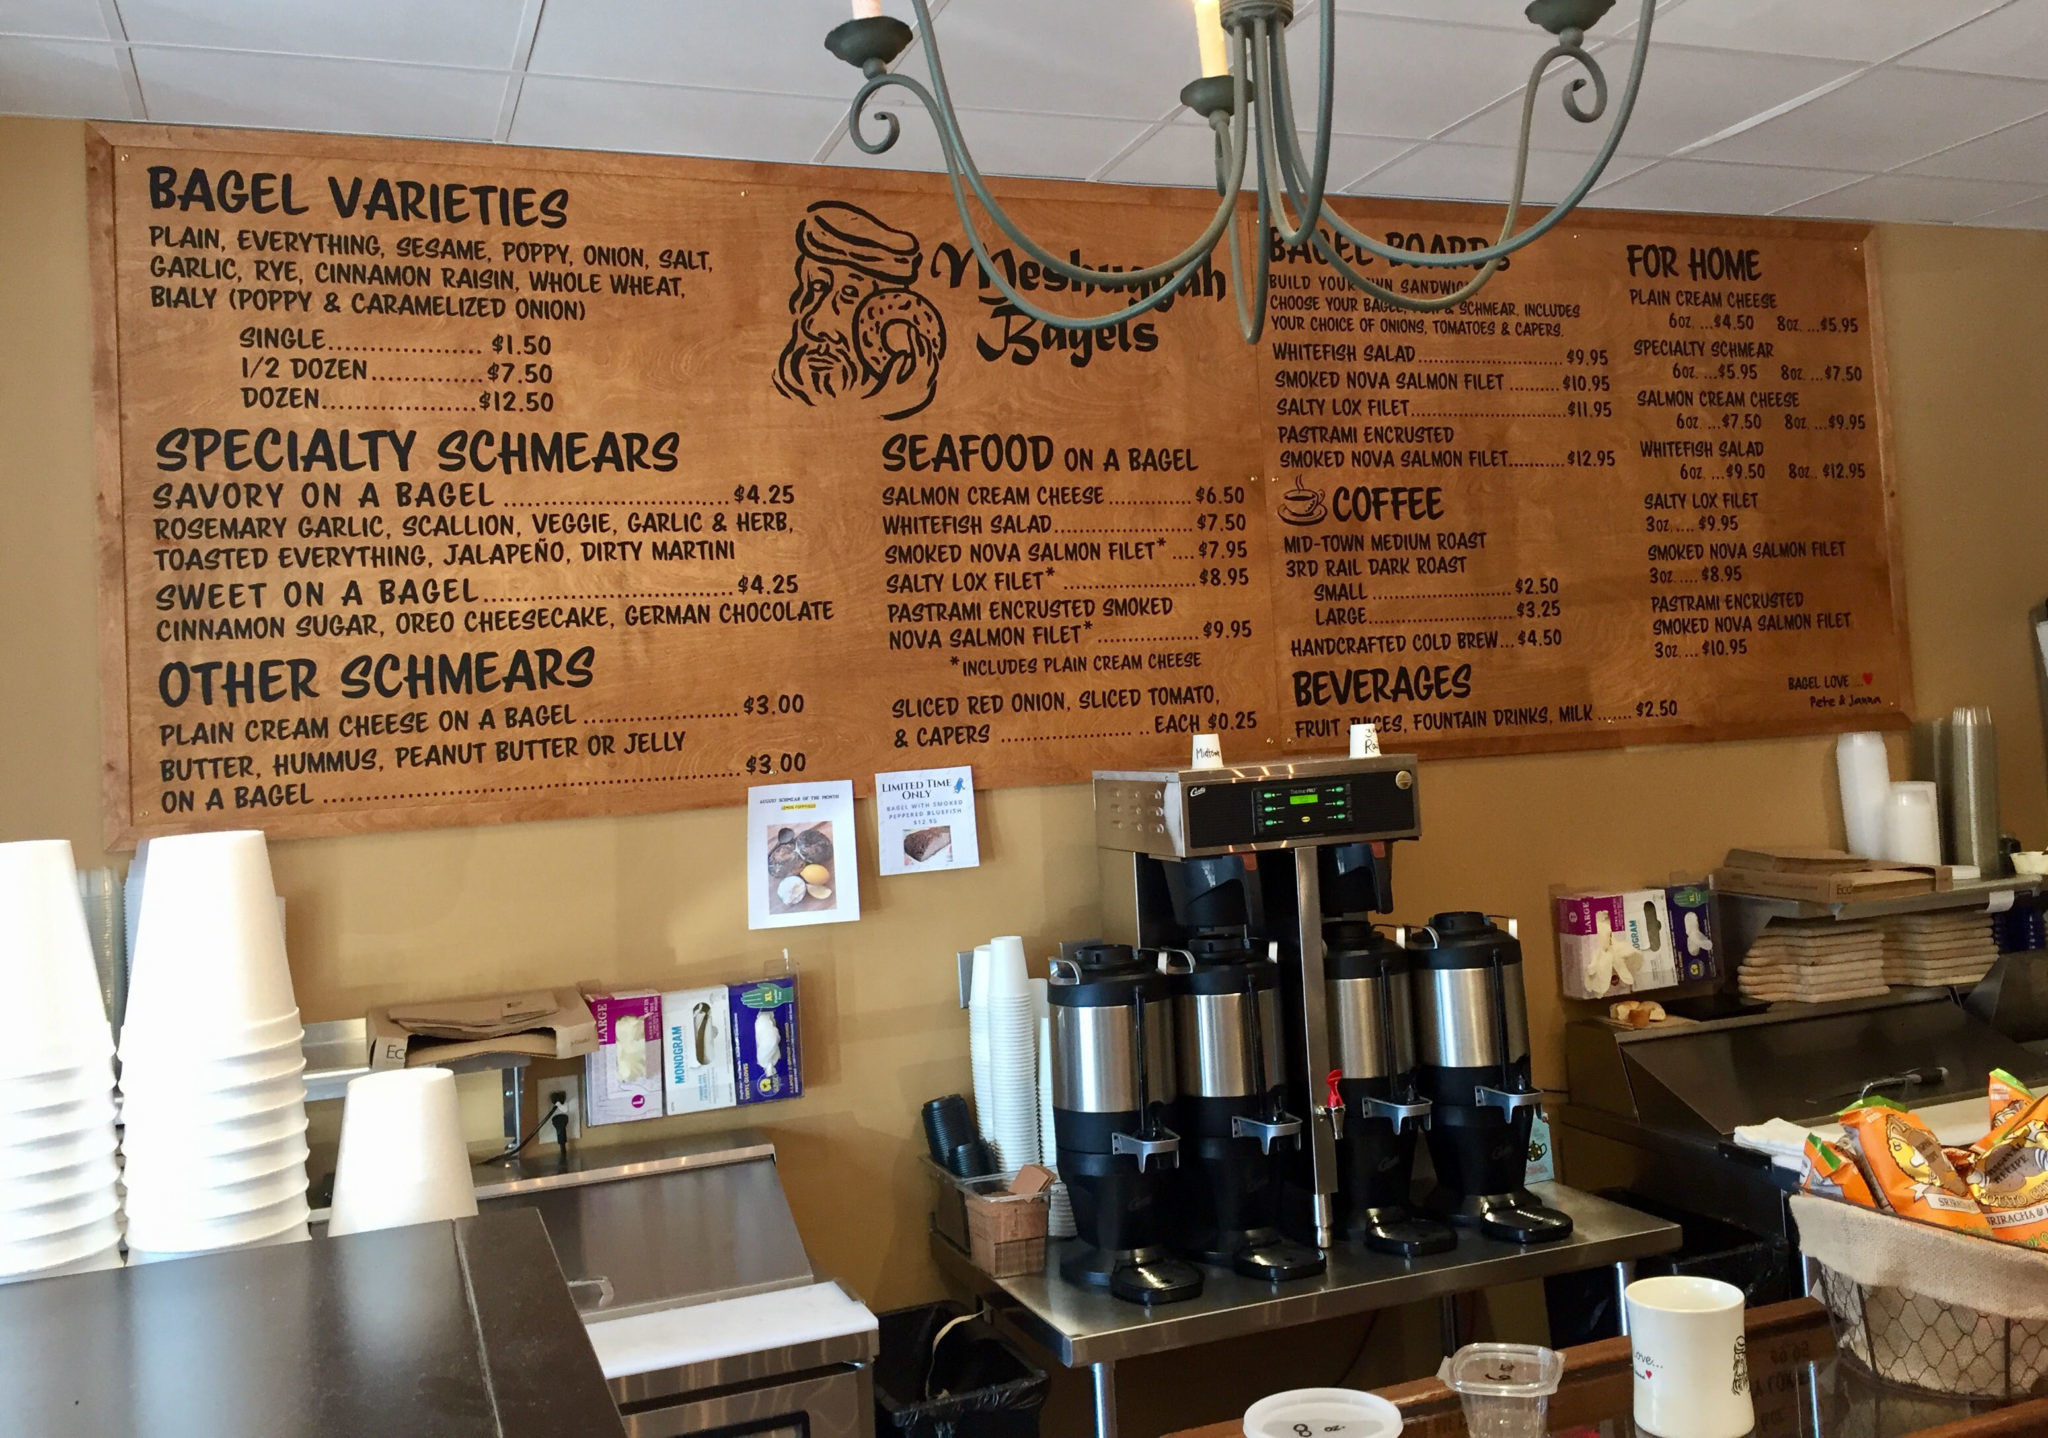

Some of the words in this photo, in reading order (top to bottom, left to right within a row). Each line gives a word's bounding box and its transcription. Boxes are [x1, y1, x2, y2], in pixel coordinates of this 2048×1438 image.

[147, 166, 309, 215] BAGEL
[328, 177, 568, 228] VARIETIES
[149, 226, 225, 252] PLAIN,
[237, 230, 384, 258] EVERYTHING,
[397, 237, 491, 263] SESAME,
[502, 242, 572, 266] POPPY,
[584, 245, 649, 270] ONION,
[659, 249, 712, 272] SALT,
[1627, 244, 1679, 278] FOR
[1688, 247, 1762, 281] HOME
[151, 255, 241, 282] GARLIC,
[254, 260, 302, 285] RYE,
[315, 262, 430, 287] CINNAMON
[441, 268, 519, 292] RAISIN,
[529, 271, 601, 293] WHOLE
[610, 274, 684, 298] WHEAT,
[150, 286, 217, 309] BIALY
[230, 288, 312, 312] (POPPY
[352, 293, 506, 318] CARAMELIZED
[516, 298, 585, 320] ONION)
[1630, 289, 1670, 305] PLAIN
[1676, 290, 1722, 307] CREAM
[1727, 292, 1777, 309] CHEESE
[976, 304, 1158, 368] Bagels
[1432, 320, 1495, 335] TOMATOES
[1273, 342, 1356, 362] WHITEFISH
[1567, 349, 1608, 365] $9.95
[1634, 339, 1705, 356] SPECIALTY
[1711, 341, 1774, 358] SCHMEAR
[290, 358, 366, 380] DOZEN
[1275, 370, 1340, 388] SMOKED
[1347, 371, 1390, 389] NOVA
[1396, 372, 1457, 390] SALMON
[1464, 374, 1504, 390] FILET
[1563, 375, 1610, 391] $10.95
[479, 391, 553, 412] $12.50
[1277, 398, 1325, 415] SALTY
[1332, 398, 1361, 416] LOX
[156, 428, 416, 472] SPECIALTY
[438, 430, 679, 474] SCHMEARS
[882, 433, 1053, 472] SEAFOOD
[1128, 448, 1198, 471] BAGEL
[1568, 450, 1615, 466] $12.95
[1823, 463, 1865, 479] $12.95
[153, 482, 283, 509] SAVORY
[734, 485, 794, 504] $4.25
[883, 486, 959, 506] SALMON
[968, 486, 1029, 505] CREAM
[1037, 487, 1104, 506] CHEESE
[1196, 486, 1244, 504] $6.50
[1333, 486, 1444, 522] COFFEE
[153, 516, 286, 540] ROSEMARY
[298, 516, 390, 539] GARLIC,
[403, 515, 520, 537] SCALLION,
[532, 513, 617, 535] VEGGIE,
[736, 512, 792, 533] HERB,
[883, 515, 982, 536] WHITEFISH
[1197, 513, 1246, 531] $7.50
[1699, 515, 1738, 531] $9.95
[885, 544, 961, 564] SMOKED
[971, 543, 1020, 562] NOVA
[1028, 542, 1100, 561] SALMON
[1199, 541, 1247, 558] $7.95
[1284, 534, 1364, 553] MID-TOWN
[1371, 533, 1430, 551] MEDIUM
[1437, 532, 1486, 549] ROAST
[1648, 544, 1703, 561] SMOKED
[1710, 543, 1747, 559] NOVA
[1753, 542, 1806, 558] SALMON
[1812, 541, 1845, 556] FILET
[153, 548, 268, 571] TOASTED
[278, 545, 432, 568] EVERYTHING,
[443, 538, 570, 565] JALAPEÑO,
[581, 541, 642, 561] DIRTY
[652, 540, 734, 560] MARTINI
[1286, 560, 1318, 577] 3RD
[1325, 559, 1362, 576] RAIL
[1368, 558, 1409, 575] DARK
[156, 583, 267, 611] SWEET
[1516, 578, 1558, 594] $2.50
[888, 602, 981, 623] PASTRAMI
[989, 599, 1095, 620] ENCRUSTED
[1103, 597, 1172, 616] SMOKED
[1517, 600, 1560, 618] $3.25
[1651, 595, 1720, 612] PASTRAMI
[1725, 592, 1804, 610] ENCRUSTED
[156, 617, 284, 642] CINNAMON
[296, 614, 384, 637] SUGAR,
[396, 611, 454, 634] OREO
[465, 607, 614, 633] CHEESECAKE,
[625, 604, 710, 626] GERMAN
[720, 601, 834, 624] CHOCOLATE
[890, 629, 942, 650] NOVA
[1291, 636, 1406, 656] HANDCRAFTED
[1702, 639, 1747, 656] $10.95
[1043, 657, 1086, 672] PLAIN
[1148, 652, 1201, 669] CHEESE
[159, 659, 320, 708] OTHER
[341, 646, 595, 699] SCHMEARS
[1292, 664, 1471, 707] BEVERAGES
[1788, 676, 1820, 690] BAGEL
[892, 697, 959, 718] SLICED
[1012, 692, 1070, 712] ONION,
[1148, 685, 1219, 705] TOMATO,
[159, 722, 233, 746] PLAIN
[245, 717, 328, 742] CREAM
[339, 712, 429, 737] CHEESE
[504, 704, 576, 728] BAGEL
[744, 694, 804, 715] $3.00
[1208, 711, 1257, 730] $0.25
[1295, 719, 1340, 738] FRUIT
[1414, 711, 1486, 730] FOUNTAIN
[1493, 707, 1552, 726] DRINKS,
[1559, 704, 1592, 722] MILK
[160, 756, 260, 782] BUTTER,
[273, 748, 383, 776] HUMMUS,
[395, 743, 486, 768] PEANUT
[624, 731, 685, 754] JELLY
[882, 780, 924, 793] LIMITED
[927, 778, 952, 788] TIME
[901, 789, 931, 800] ONLY
[886, 804, 908, 812] BAGEL
[912, 802, 930, 810] WITH
[932, 799, 963, 807] SMOKED
[888, 811, 924, 820] PEPPERED
[926, 807, 962, 817] BLUEFISH
[1582, 900, 1592, 934] LARGE
[597, 1003, 608, 1044] LARGE
[671, 1025, 686, 1085] MONOGRAM
